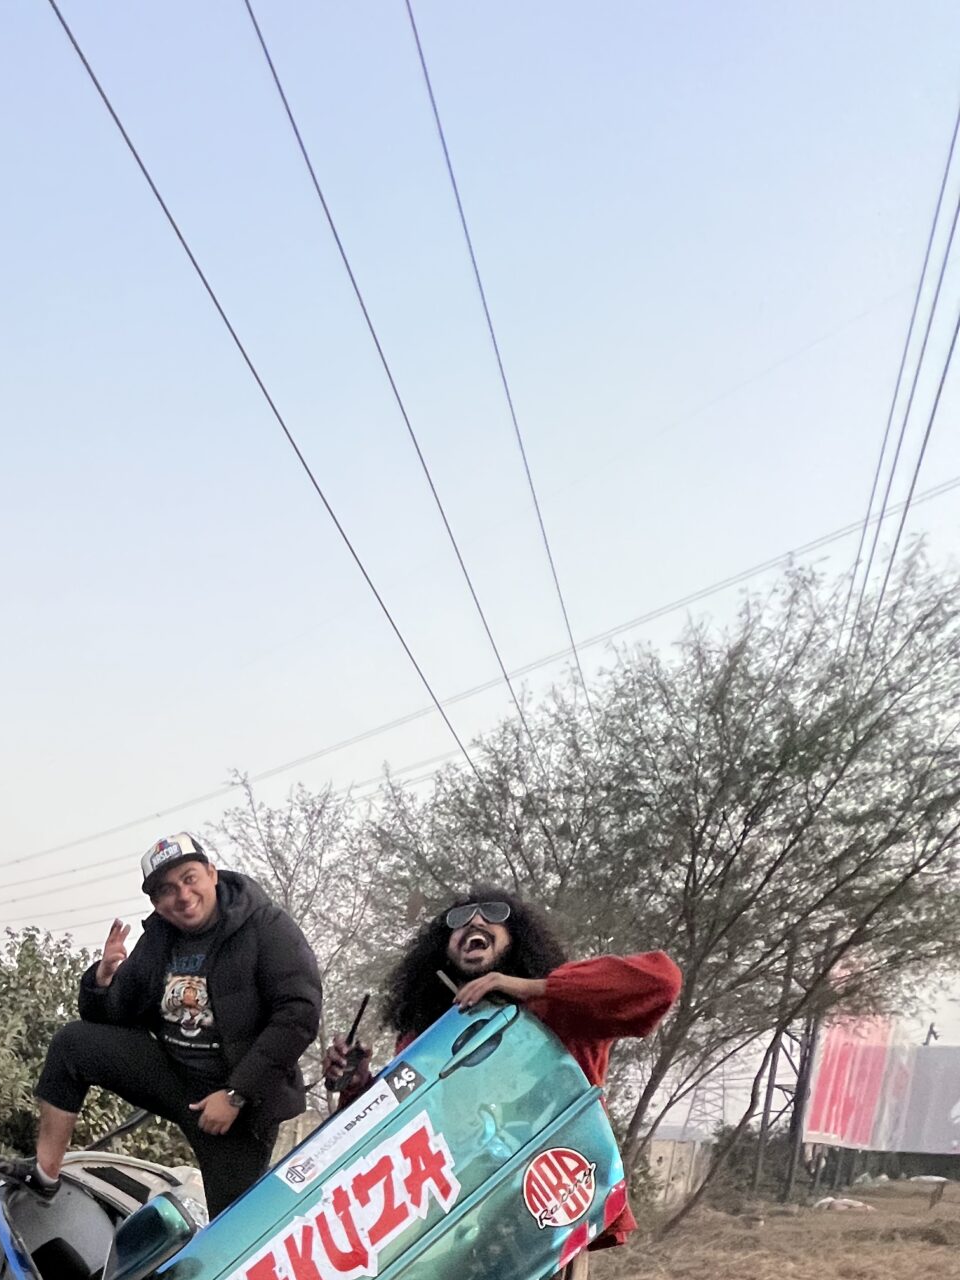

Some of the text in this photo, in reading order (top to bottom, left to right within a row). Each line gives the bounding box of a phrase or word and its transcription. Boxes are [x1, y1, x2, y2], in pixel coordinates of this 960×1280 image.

[344, 1093, 388, 1131] BHUTTA
[393, 1067, 416, 1090] 46
[539, 1164, 596, 1227] Racing
